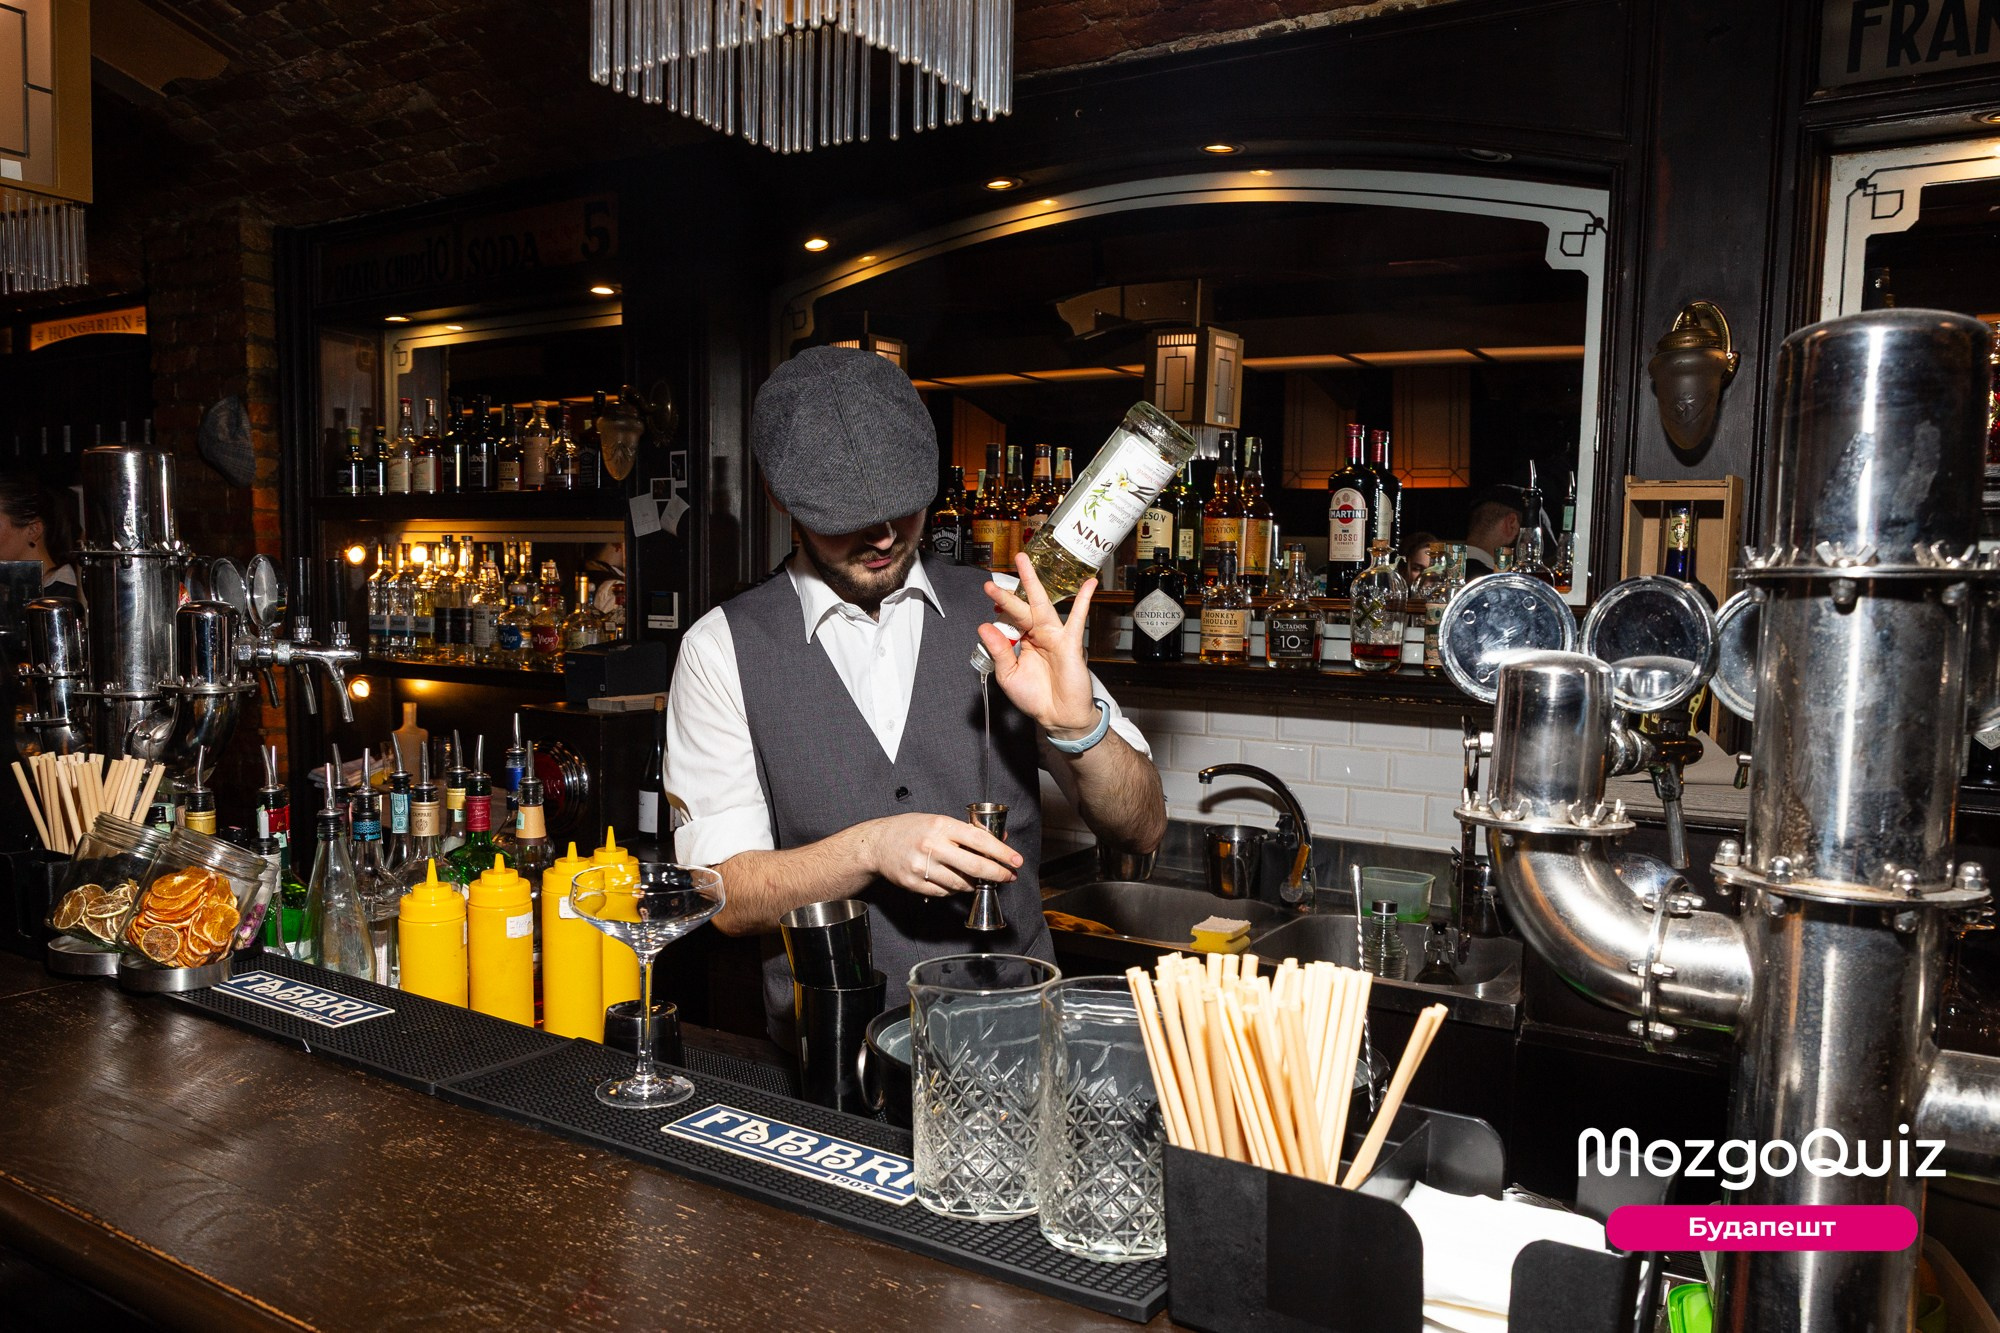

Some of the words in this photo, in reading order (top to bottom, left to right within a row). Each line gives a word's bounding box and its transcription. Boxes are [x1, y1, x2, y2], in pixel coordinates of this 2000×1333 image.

[581, 201, 611, 262] 5
[467, 231, 540, 275] SODA
[48, 315, 133, 342] HUNGARIAN
[1142, 512, 1167, 524] ESON
[1330, 510, 1366, 519] MARTINI
[1071, 519, 1118, 554] ONIN
[1334, 533, 1359, 542] ROSSO
[1202, 617, 1239, 626] SHOULDER
[1205, 611, 1236, 619] MONKEY
[1279, 635, 1301, 649] 10
[225, 973, 378, 1020] FABBRI
[296, 1009, 322, 1021] 1905
[830, 1174, 876, 1192] 1905
